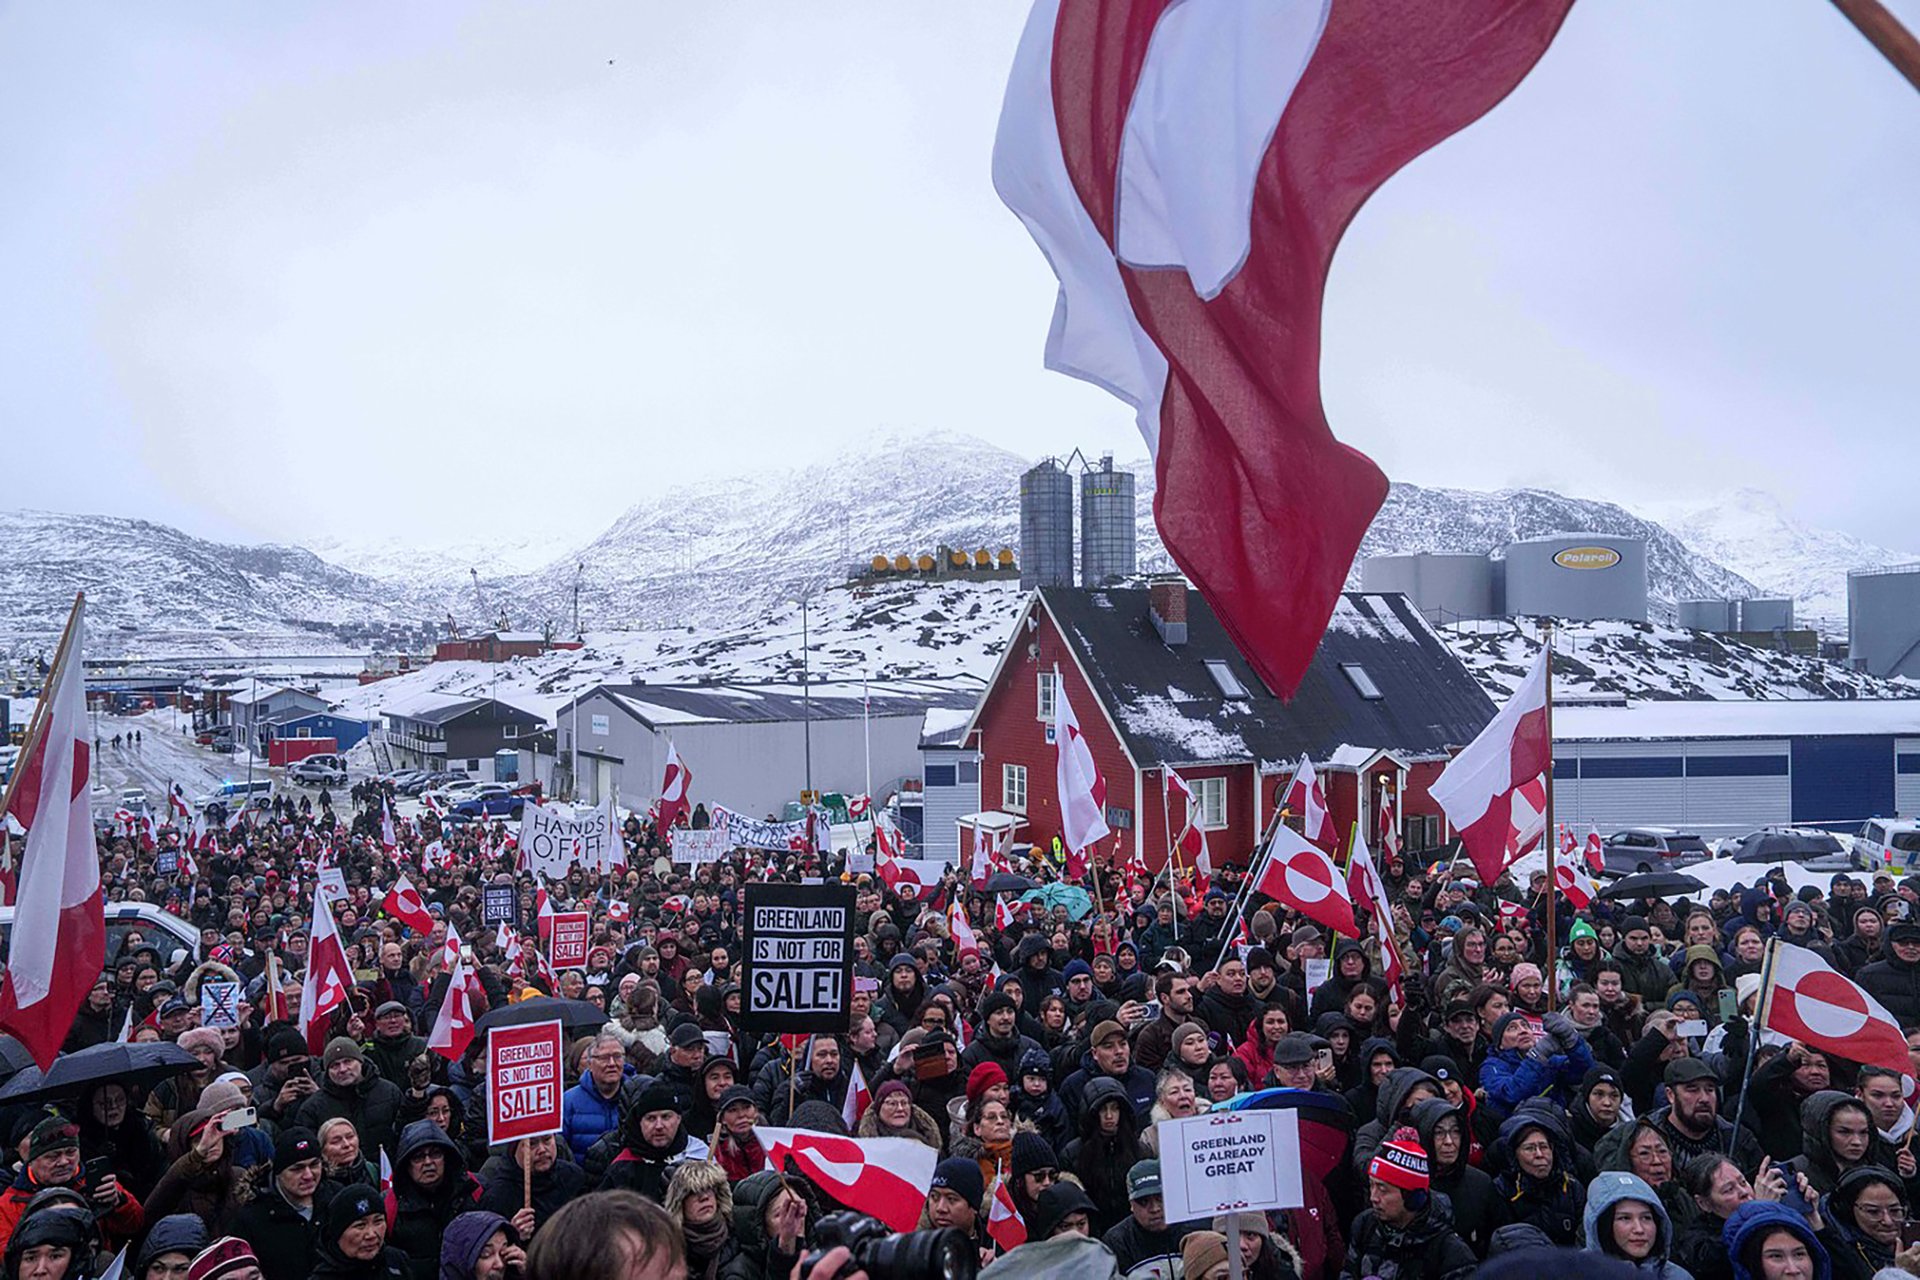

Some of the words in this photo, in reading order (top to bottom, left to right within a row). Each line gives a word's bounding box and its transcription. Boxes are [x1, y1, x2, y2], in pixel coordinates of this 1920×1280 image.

[534, 814, 605, 835] HANDS
[533, 833, 602, 860] OFF
[728, 824, 788, 849] FUTURE
[757, 909, 843, 930] GREENLAND
[755, 940, 769, 959] IS
[776, 941, 806, 960] NOT
[813, 941, 841, 959] FOR
[753, 971, 840, 1009] SALE!
[500, 1043, 552, 1063] GREENLAND
[500, 1070, 509, 1084] IS
[513, 1066, 530, 1081] NOT
[535, 1064, 552, 1078] FOR
[501, 1084, 552, 1120] SALE!
[1191, 1134, 1266, 1151] GREENLAND
[1194, 1153, 1205, 1164] IS
[1208, 1147, 1265, 1162] ALREADY
[1205, 1161, 1255, 1177] GREAT
